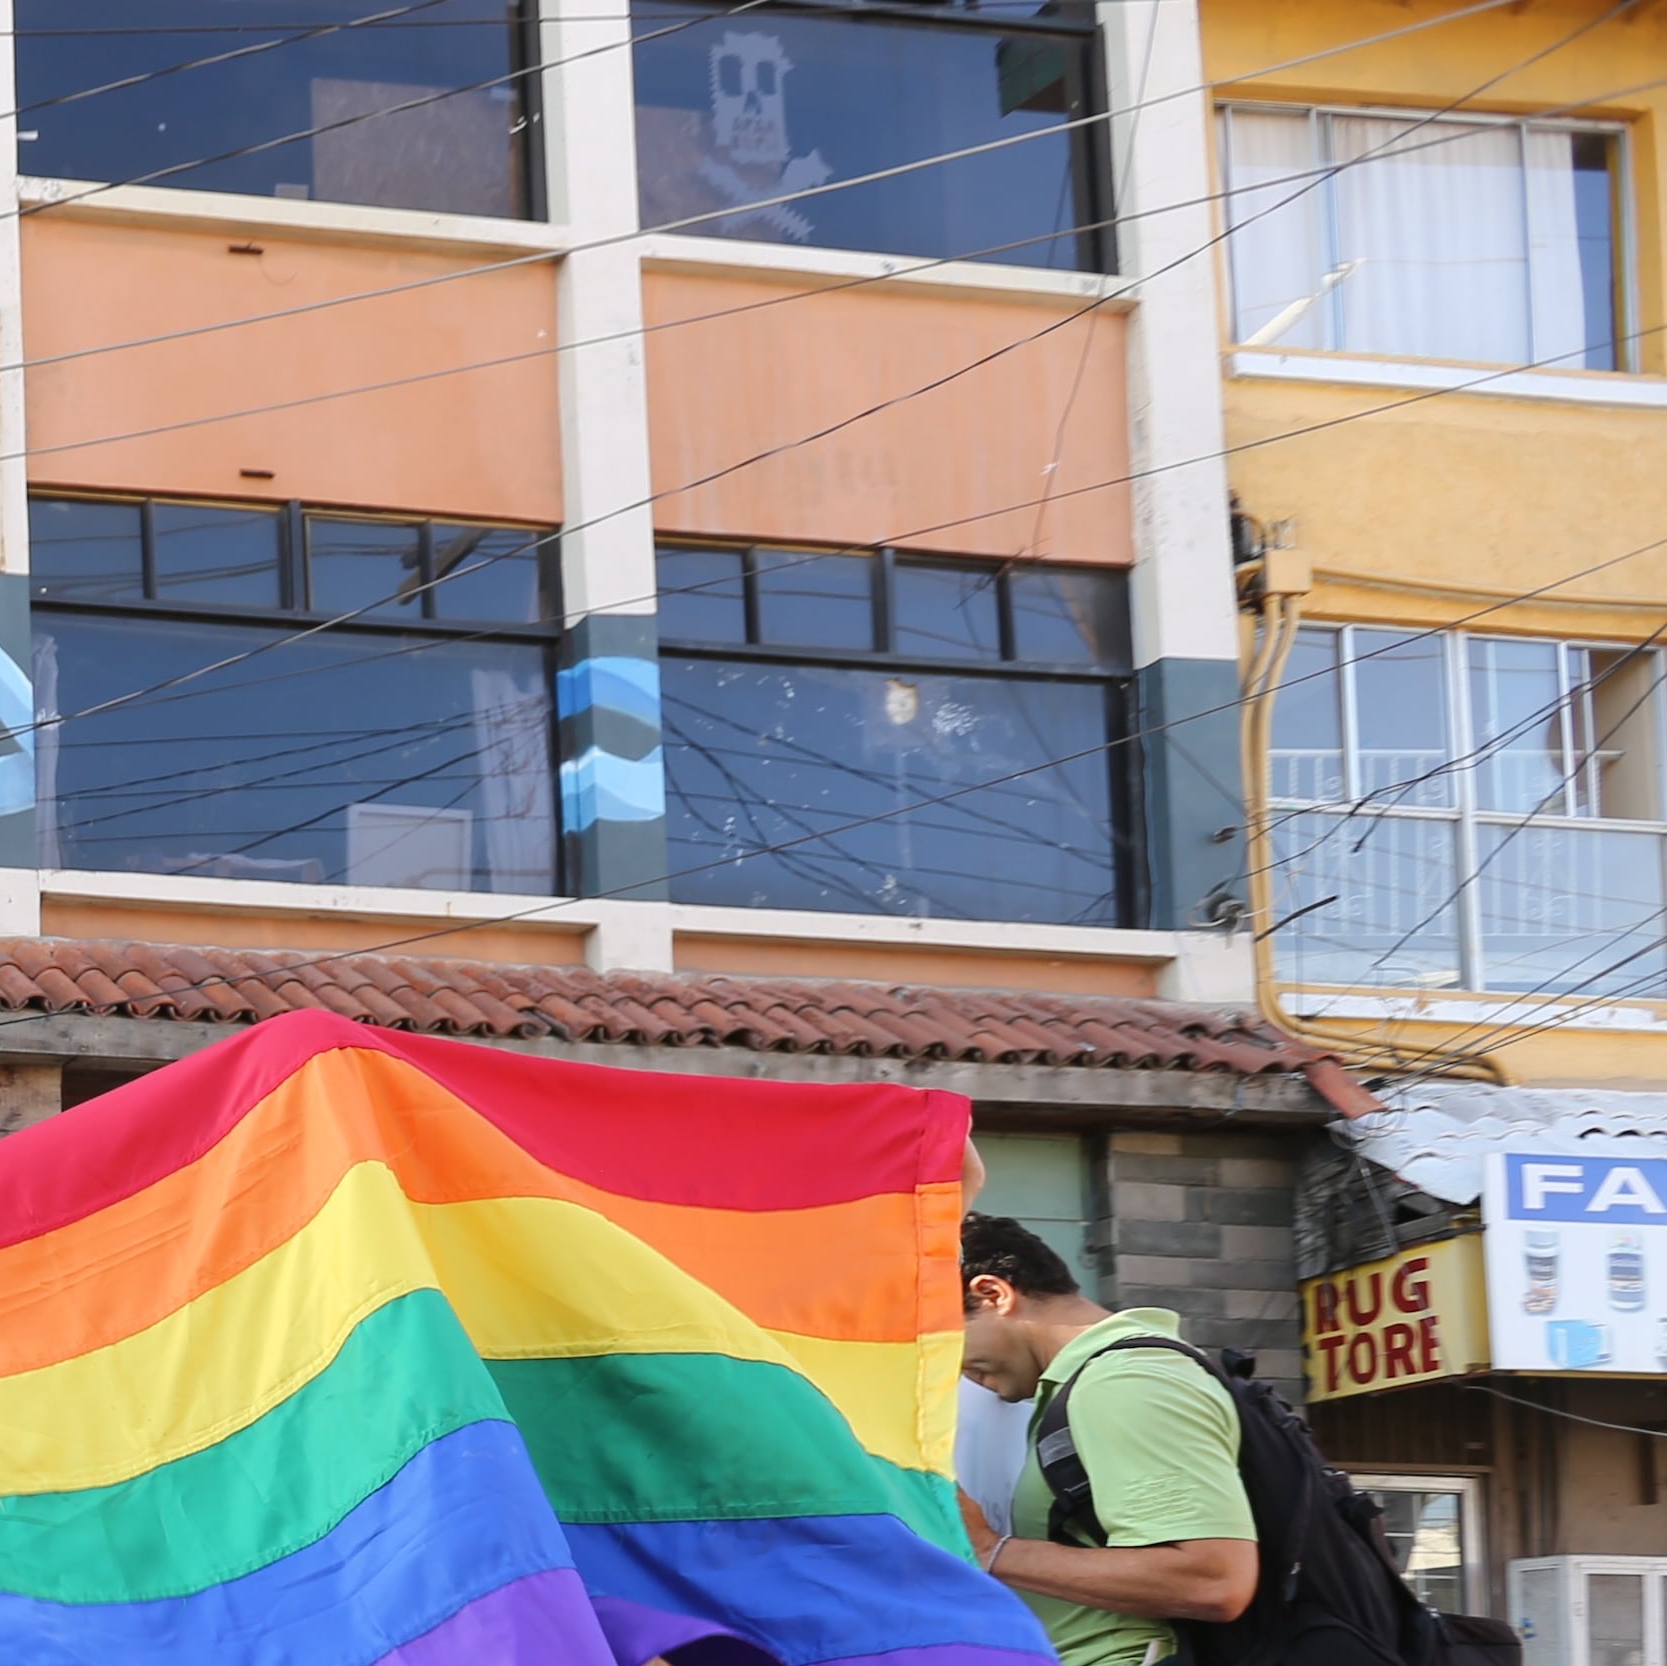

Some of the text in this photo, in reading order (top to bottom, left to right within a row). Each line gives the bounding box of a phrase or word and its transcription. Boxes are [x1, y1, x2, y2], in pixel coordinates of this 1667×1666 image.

[1521, 1163, 1667, 1214] FA
[1313, 1257, 1431, 1335] RUG
[1317, 1315, 1442, 1394] TORE
